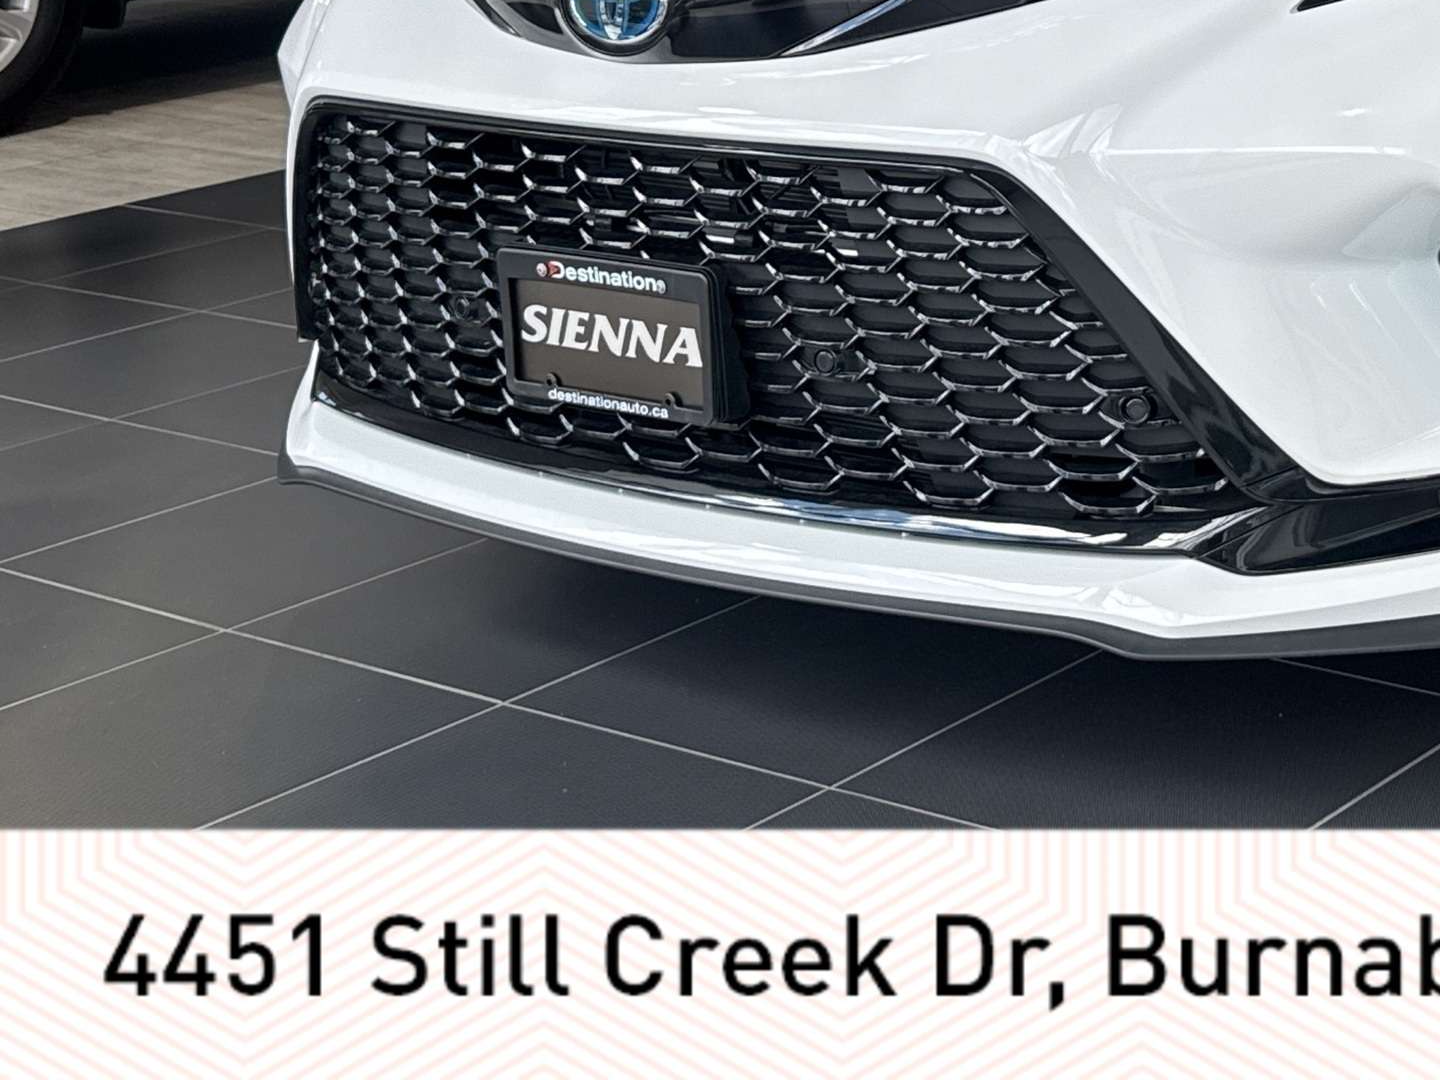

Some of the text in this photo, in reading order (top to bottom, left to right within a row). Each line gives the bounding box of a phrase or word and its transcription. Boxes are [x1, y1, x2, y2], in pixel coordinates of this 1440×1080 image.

[546, 260, 658, 292] Destination
[520, 304, 704, 368] SIENNA
[547, 387, 669, 419] destinationauto.ca
